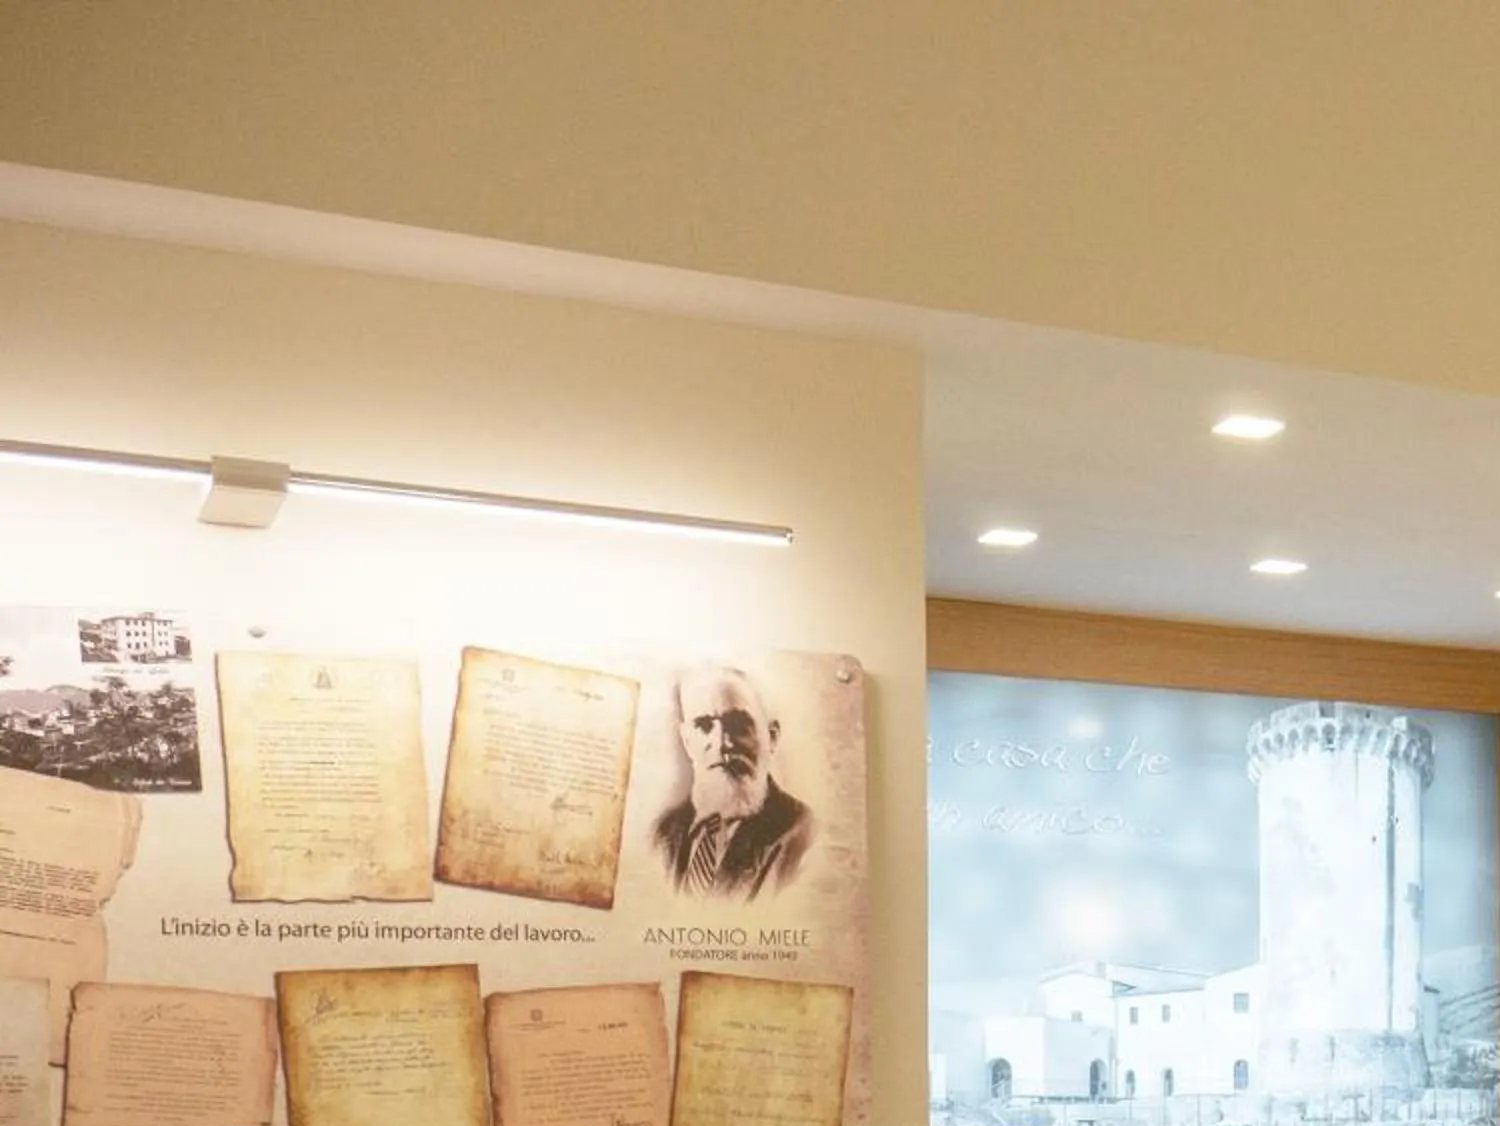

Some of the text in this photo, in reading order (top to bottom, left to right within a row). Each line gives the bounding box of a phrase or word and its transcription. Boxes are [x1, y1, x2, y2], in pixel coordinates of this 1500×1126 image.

[236, 919, 249, 937] è
[254, 919, 272, 937] la
[278, 922, 332, 942] parte
[336, 920, 369, 943] più
[374, 921, 485, 942] importante
[489, 924, 519, 941] del
[524, 924, 596, 943] lavoro...
[643, 927, 811, 947] ANTONIO MIELE
